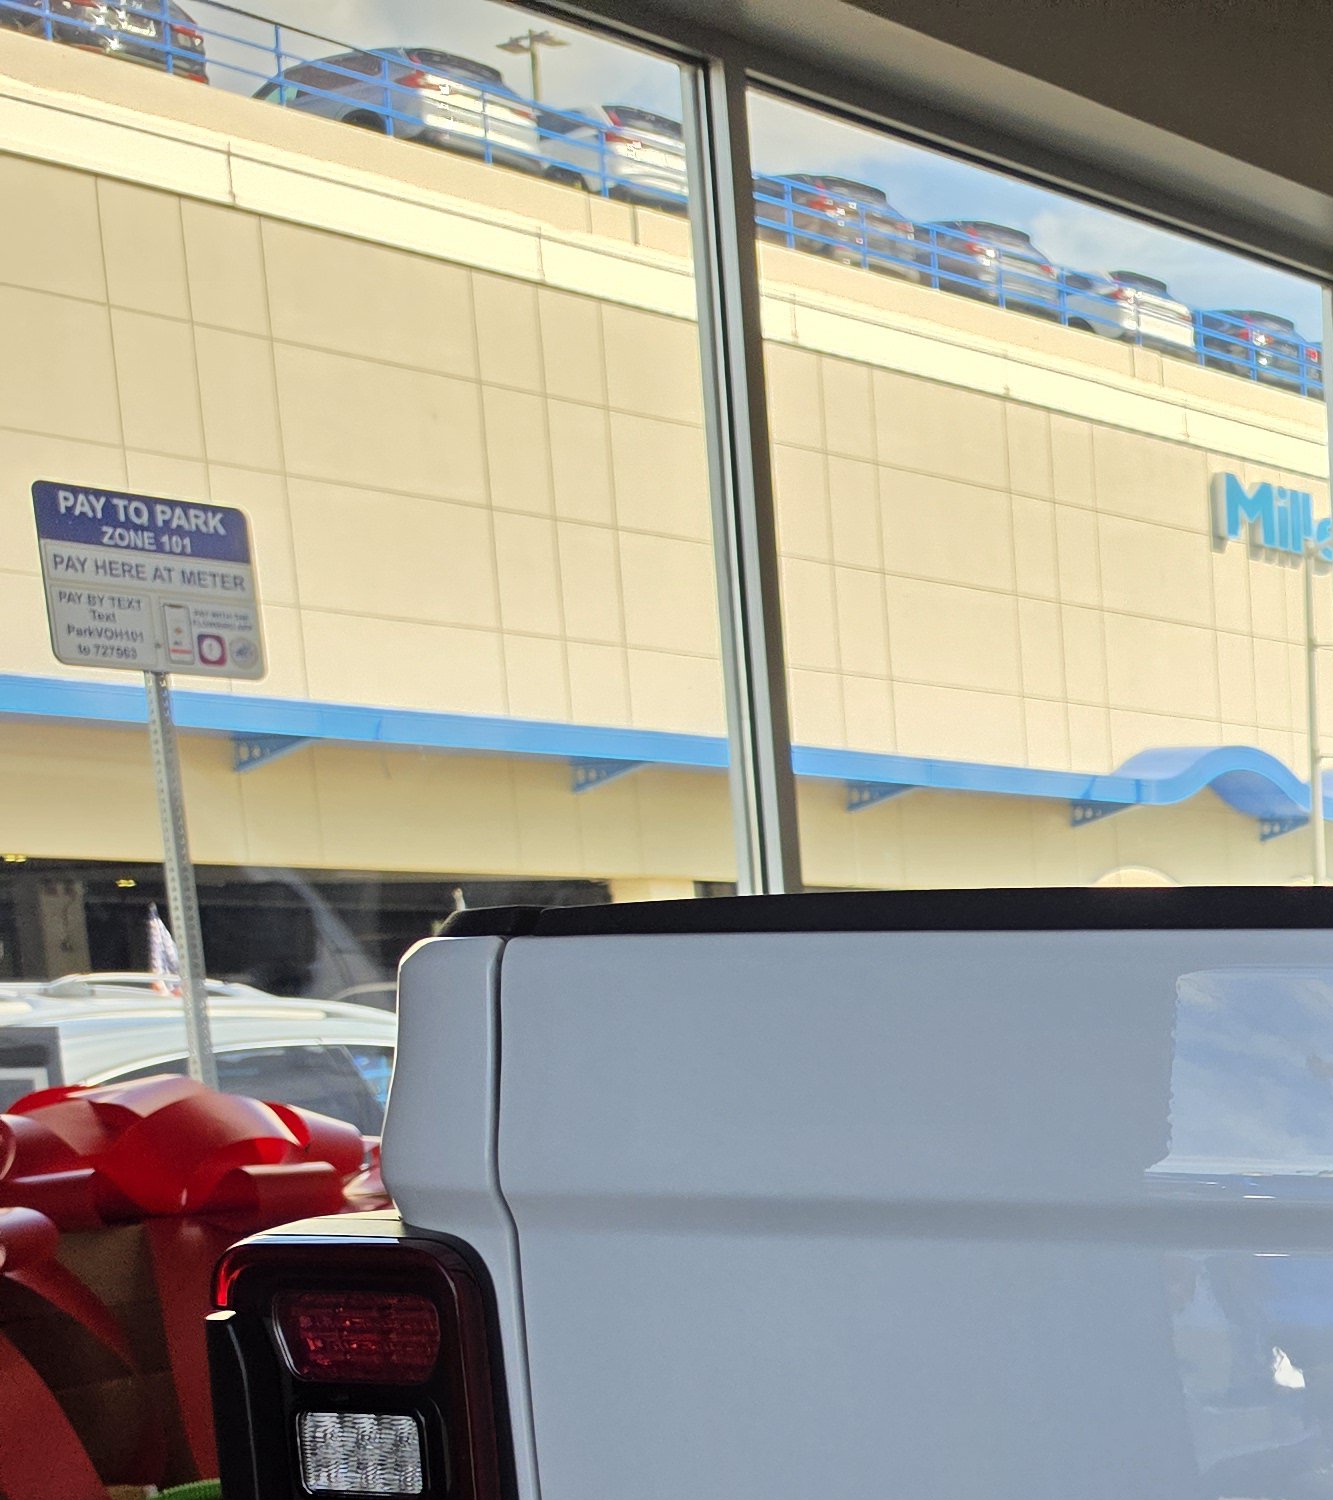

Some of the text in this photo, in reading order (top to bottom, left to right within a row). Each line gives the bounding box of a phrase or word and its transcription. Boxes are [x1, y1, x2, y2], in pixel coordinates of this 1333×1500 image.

[57, 489, 227, 536] PAY TO PARK
[101, 525, 192, 555] ZONE 101
[53, 553, 246, 592] PAY HERE AT METER
[58, 590, 142, 611] PAY BY TEXT
[89, 608, 117, 623] Text
